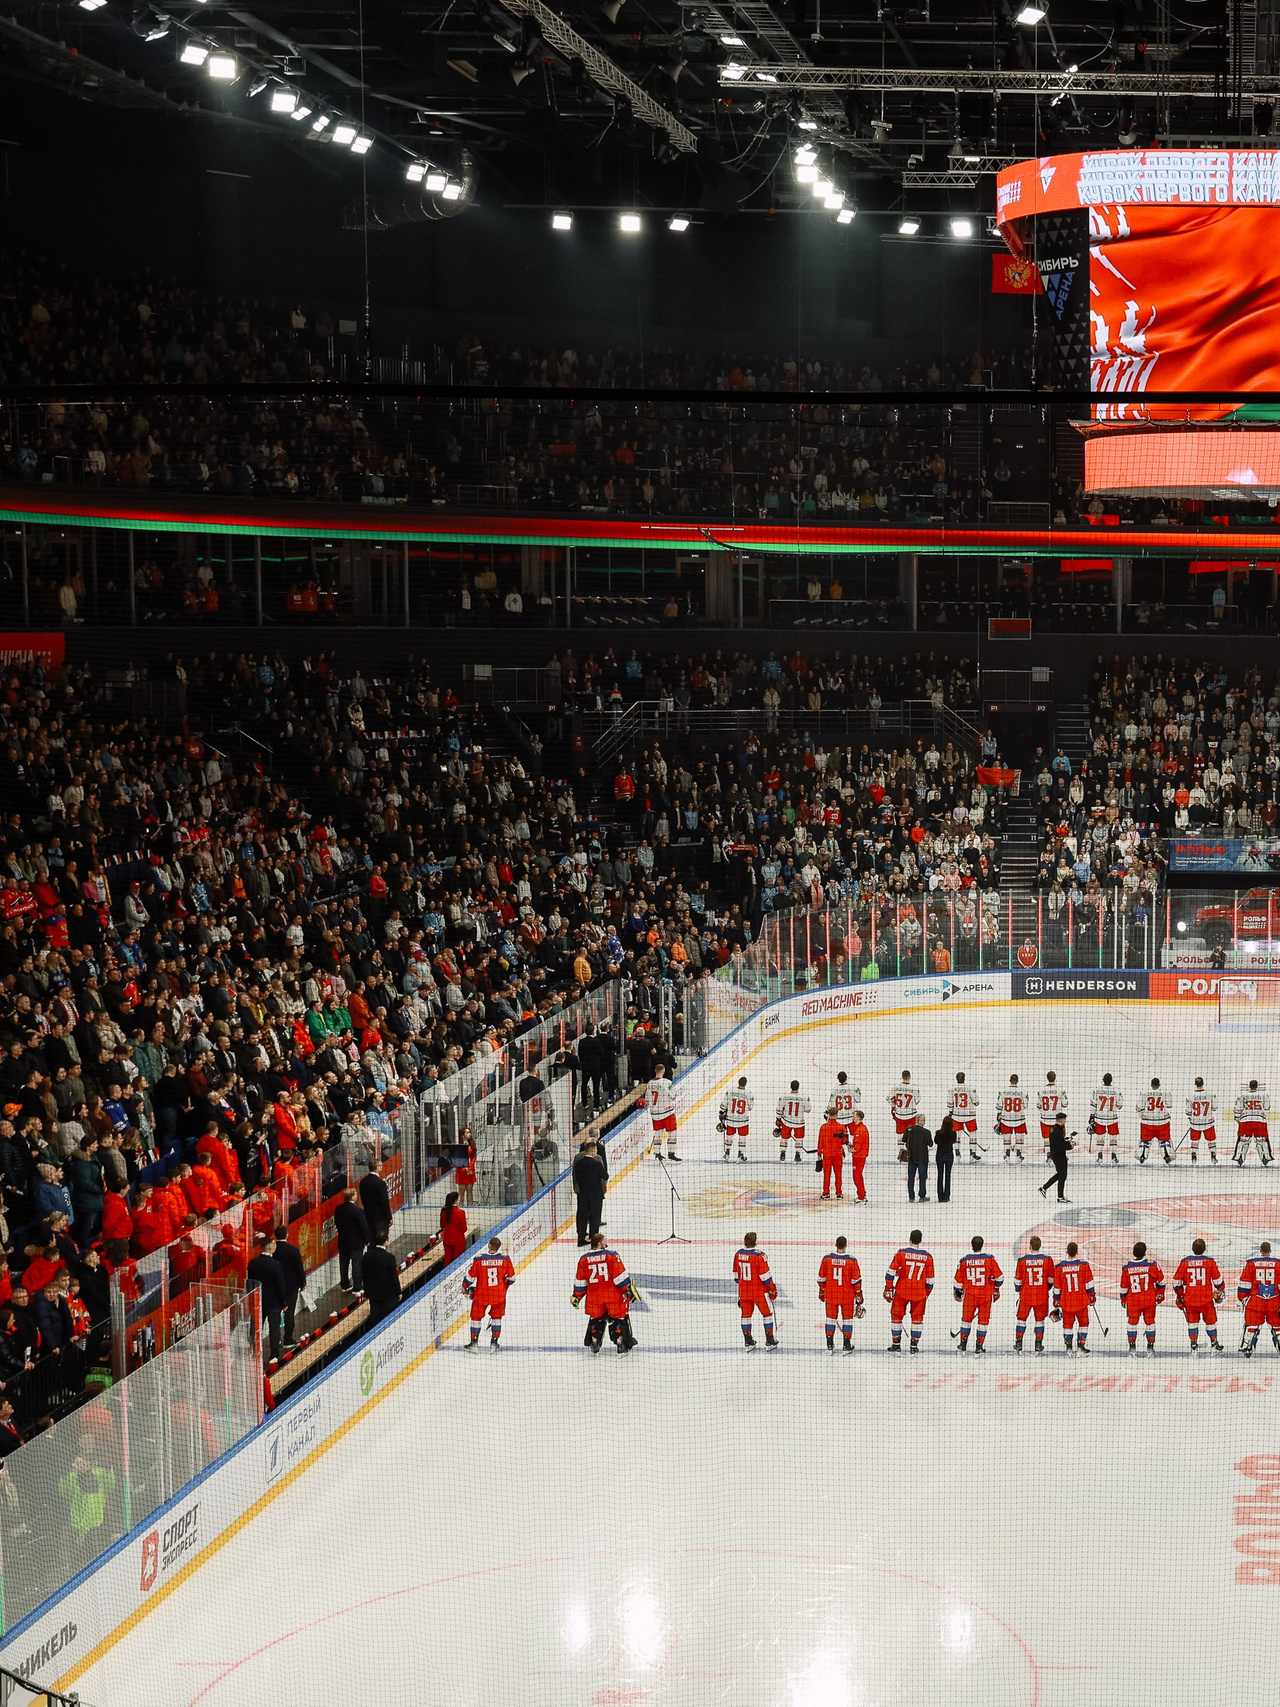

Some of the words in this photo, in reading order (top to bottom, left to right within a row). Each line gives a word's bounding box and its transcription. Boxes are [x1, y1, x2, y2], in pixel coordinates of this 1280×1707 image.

[1078, 183, 1142, 205] КУБОК
[1142, 183, 1228, 203] ПЕРВОГО
[1055, 271, 1076, 320] АРЕНА
[547, 717, 563, 740] P1
[1175, 844, 1226, 855] РОЛЬФ
[1176, 956, 1211, 964] РОЛЬФ
[903, 988, 941, 998] СИБИРЬ
[962, 984, 994, 992] АРЕНА
[1046, 980, 1137, 991] HENDERSON
[1177, 978, 1258, 995] РОЛЬФ
[764, 1012, 780, 1029] БАНК
[651, 1090, 659, 1106] 7
[731, 1098, 747, 1115] 19
[836, 1095, 853, 1111] 63
[953, 1092, 968, 1108] 13
[1004, 1097, 1023, 1113] 88
[1042, 1095, 1059, 1111] 87
[1099, 1095, 1115, 1112] 71
[1147, 1096, 1165, 1112] 34
[788, 1101, 800, 1117] 11
[1192, 1101, 1210, 1117] 97
[1148, 1197, 1280, 1210] CHANNEL
[486, 1267, 498, 1287] 8
[587, 1262, 609, 1284] 29
[738, 1262, 752, 1281] 10
[833, 1267, 843, 1286] 4
[905, 1261, 926, 1281] 77
[966, 1268, 986, 1287] 45
[1026, 1267, 1044, 1286] 13
[1187, 1268, 1206, 1287] 34
[1255, 1268, 1275, 1285] 99
[1065, 1273, 1079, 1292] 11
[1129, 1273, 1150, 1293] 87
[375, 1335, 405, 1372] Airlines
[996, 1374, 1277, 1395] МАШИНА
[286, 1393, 322, 1438] ПЕРВЫЙ
[287, 1425, 316, 1461] КАНАЛ
[162, 1501, 201, 1553] СПОРТ
[161, 1529, 199, 1571] ЭКСПРЕСС
